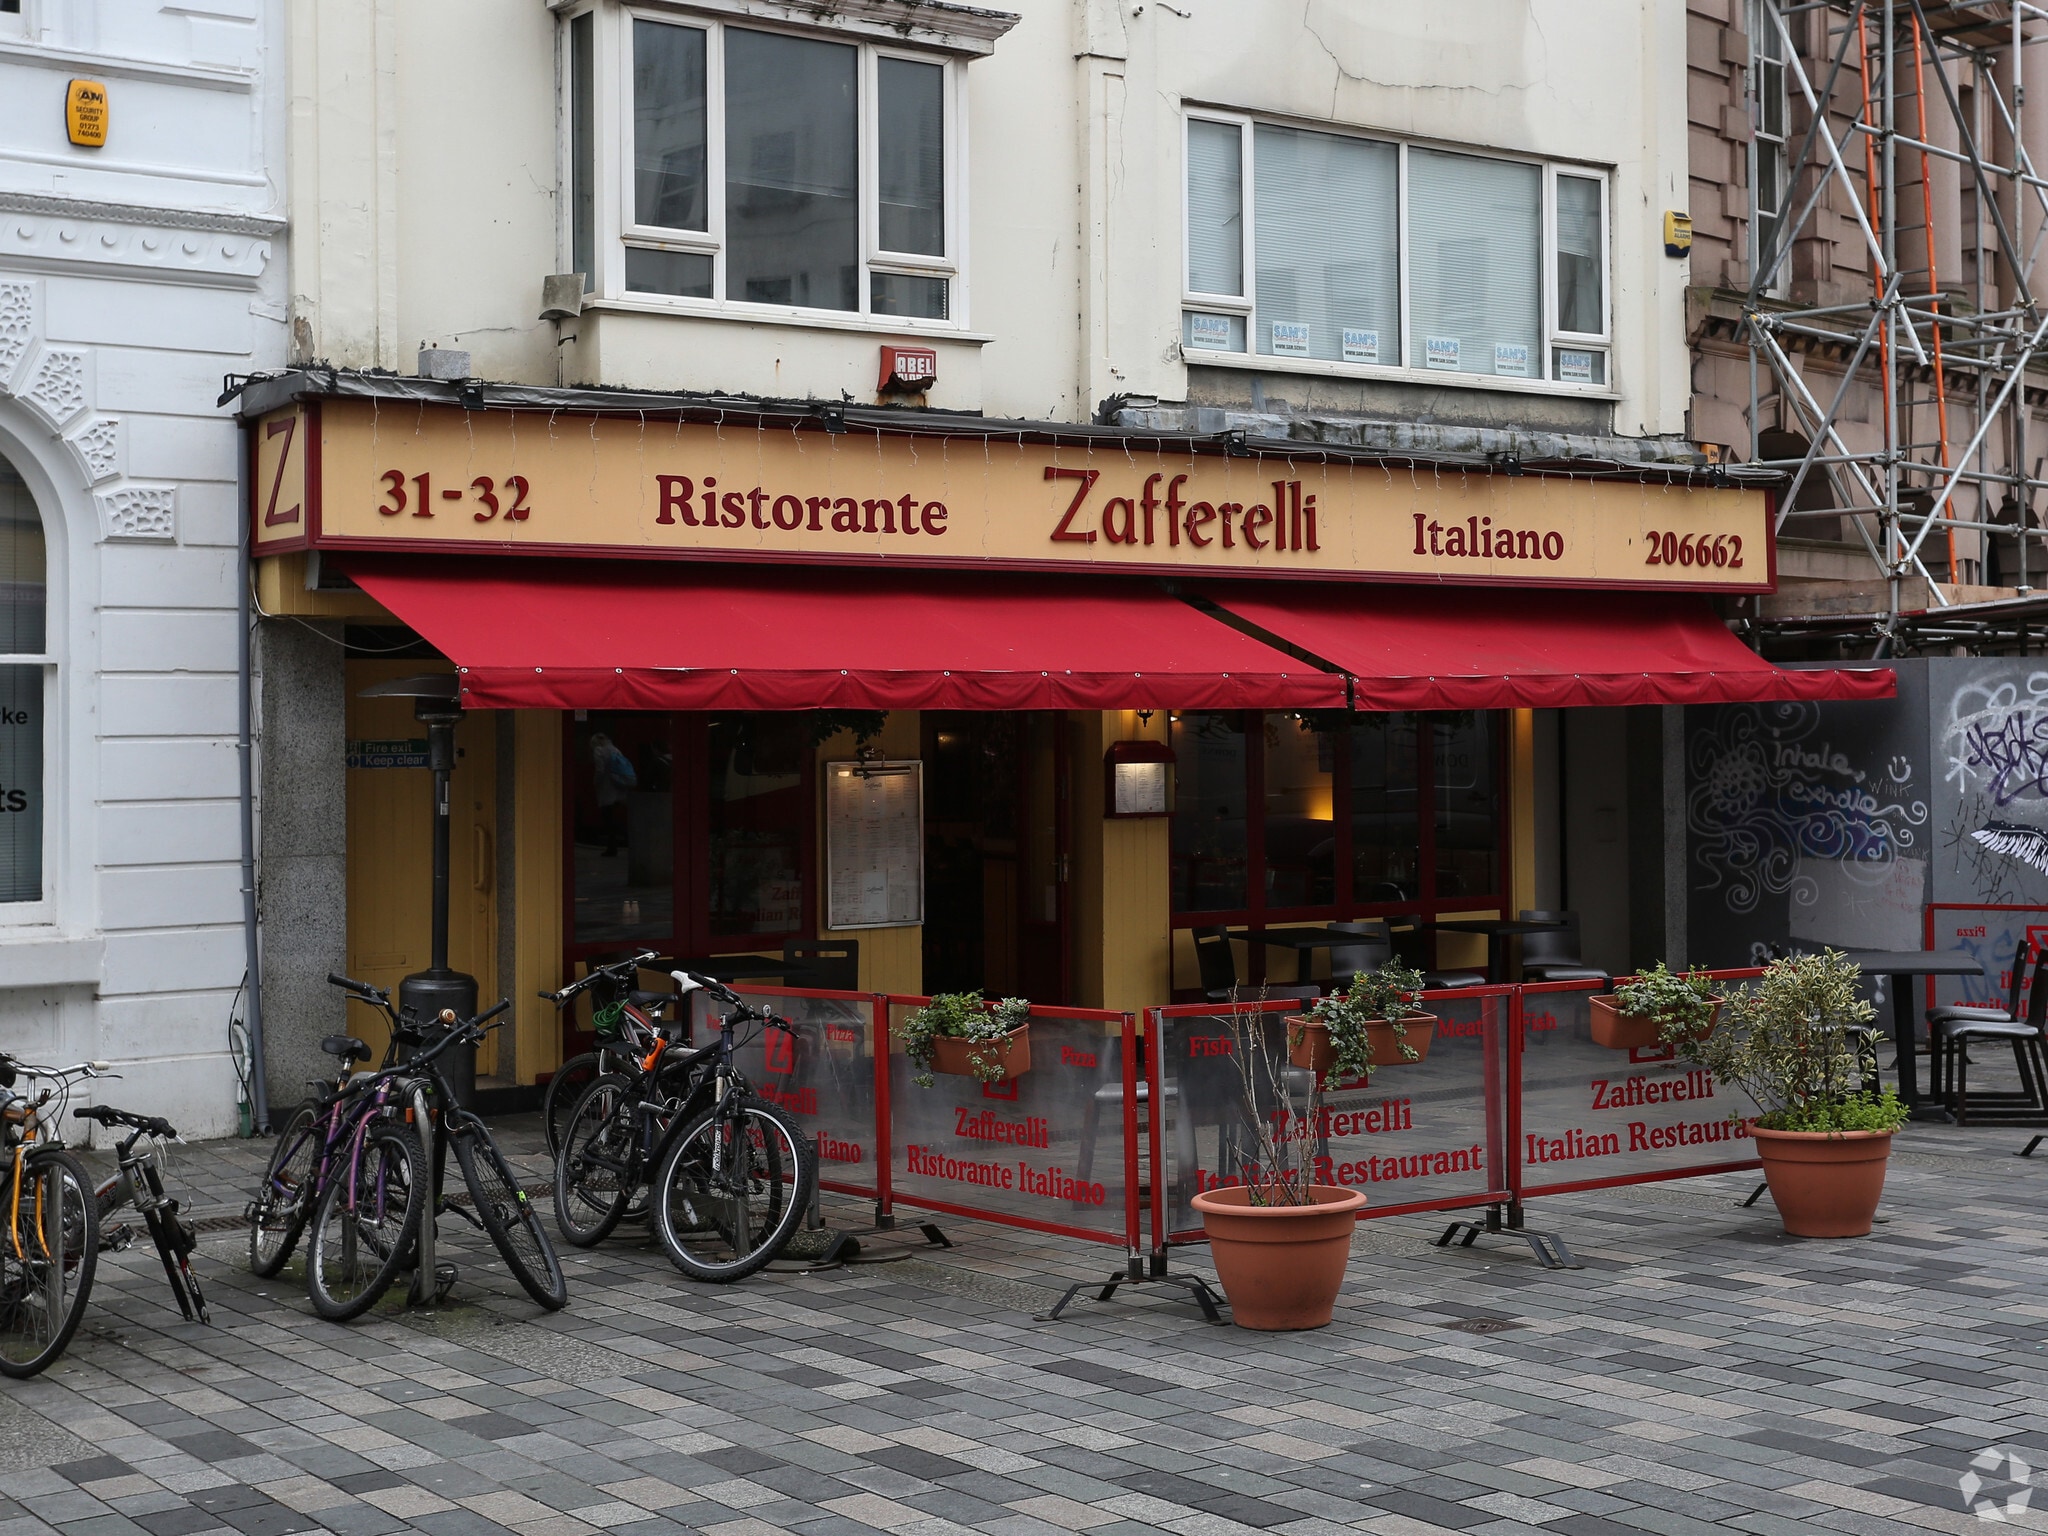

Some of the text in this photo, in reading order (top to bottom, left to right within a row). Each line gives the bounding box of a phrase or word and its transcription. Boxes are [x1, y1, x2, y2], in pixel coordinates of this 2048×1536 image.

[76, 105, 103, 115] SECURITY
[80, 113, 99, 122] GROUP
[79, 122, 99, 131] 01273
[1193, 317, 1229, 333] SAM'S
[1273, 325, 1308, 339] SAM'S
[1344, 332, 1377, 346] SAM'S
[1427, 339, 1459, 353] SAM'S
[1496, 347, 1527, 360] SAM'S
[1561, 354, 1590, 367] SAM'S
[897, 356, 933, 374] ABEL
[265, 416, 299, 528] Z
[379, 466, 1743, 568] 31-32 Ristorante Zafferelli Italiano 206662
[0, 706, 28, 725] ke
[365, 743, 412, 753] Fire exit
[365, 755, 424, 768] Keep clear
[1437, 1017, 1484, 1039] Meat
[1521, 1011, 1557, 1034] Fish
[826, 1023, 855, 1042] Pizza
[1189, 1034, 1233, 1058] Fish
[1061, 1045, 1097, 1068] Pizza
[1591, 1069, 1714, 1110] Zafferelli
[955, 1107, 1048, 1148] Zafferelli
[817, 1131, 862, 1163] liano
[1526, 1117, 1759, 1164] Italian Restaura
[907, 1144, 1106, 1206] Ristorante Italiano
[1312, 1144, 1483, 1187] Restaurant
